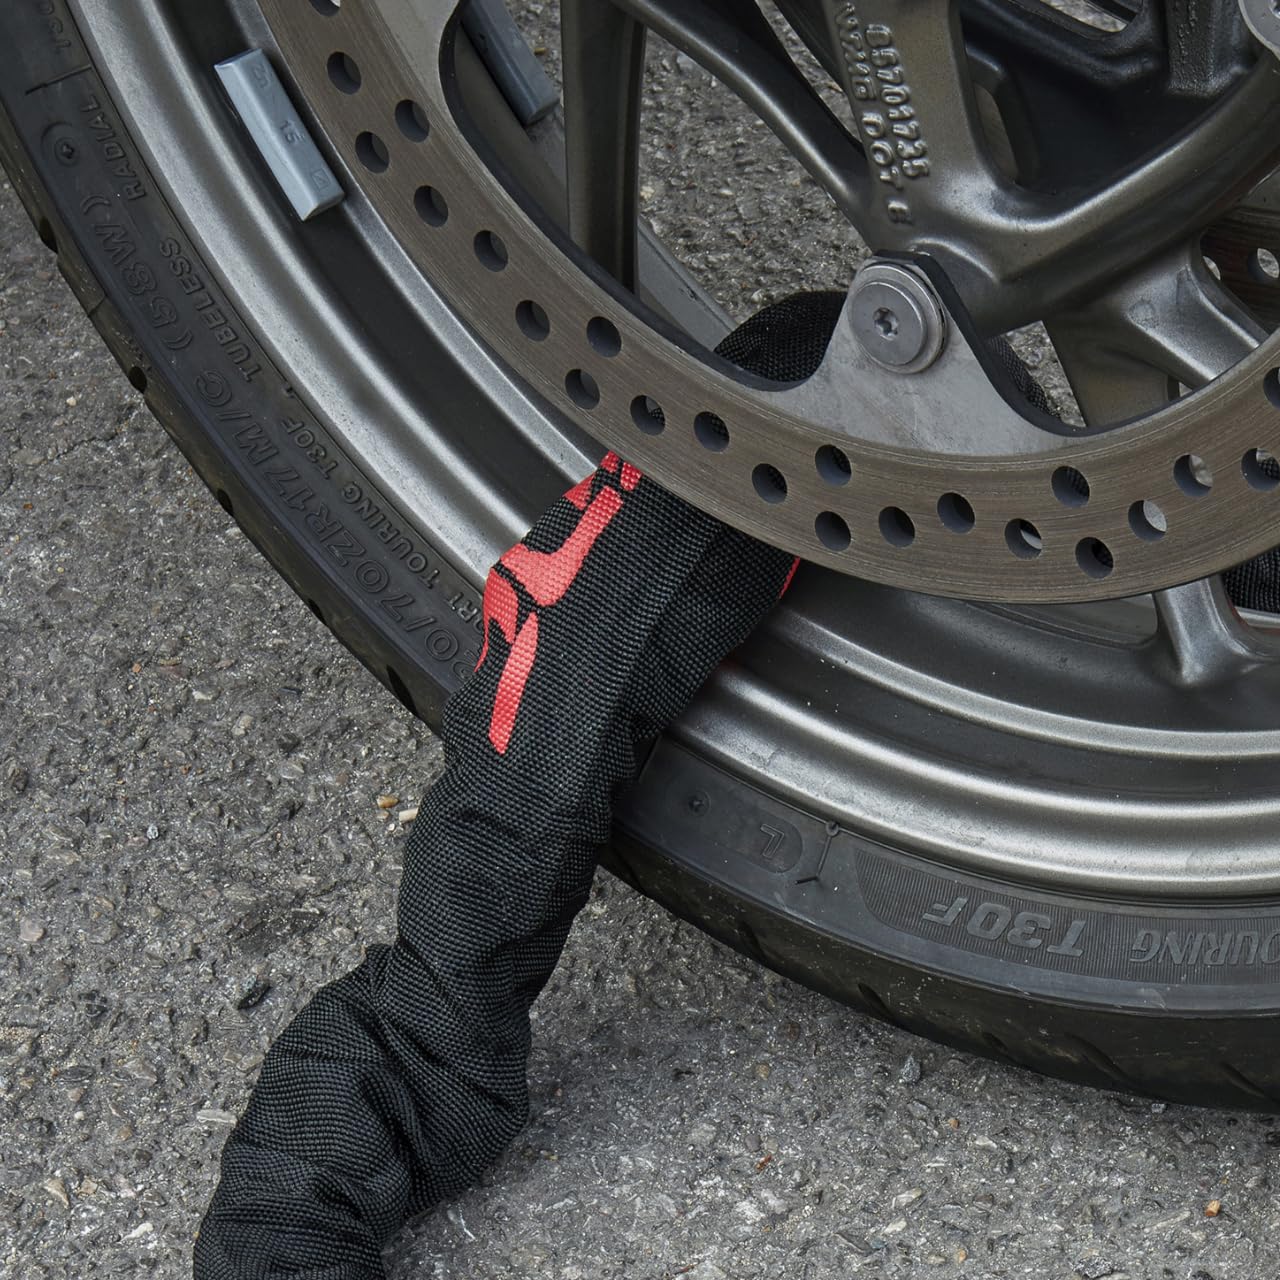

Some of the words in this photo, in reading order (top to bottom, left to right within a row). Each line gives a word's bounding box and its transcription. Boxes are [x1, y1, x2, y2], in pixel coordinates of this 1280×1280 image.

[80, 95, 147, 201] RADIAL
[160, 236, 262, 382] TUBELESS
[282, 411, 339, 480] T30F
[341, 480, 441, 590] TOURING
[921, 896, 1088, 957] T30F
